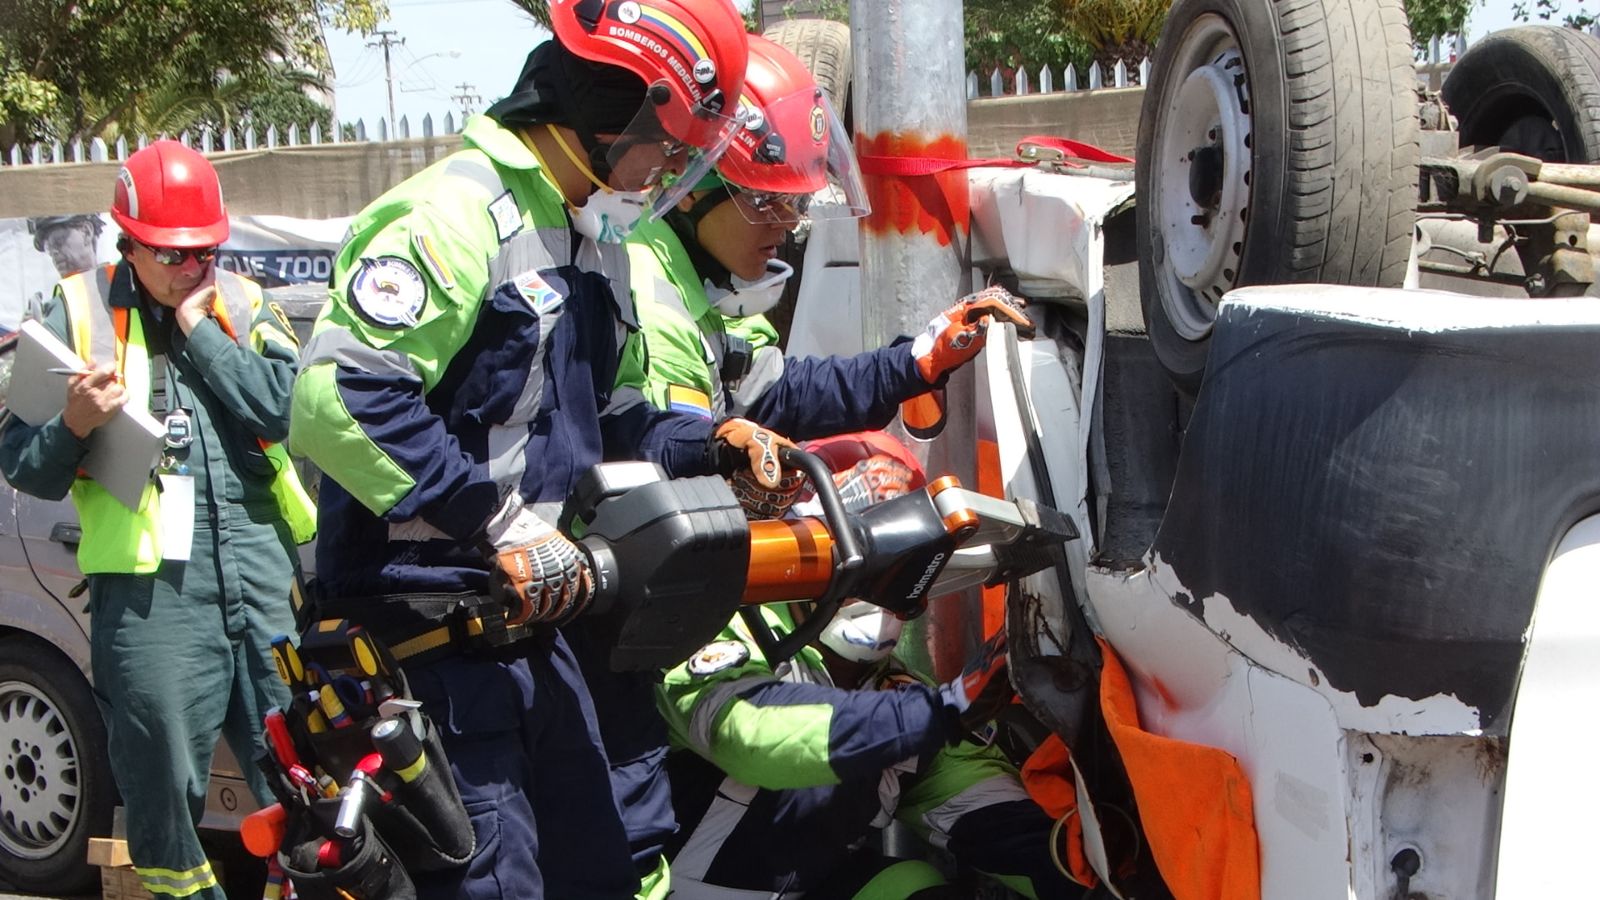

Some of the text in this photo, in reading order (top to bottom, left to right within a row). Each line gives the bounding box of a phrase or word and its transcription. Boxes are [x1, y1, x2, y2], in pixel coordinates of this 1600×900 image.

[609, 26, 702, 102] BOMBEROS MEDELLIN
[275, 255, 334, 279] TOO
[905, 552, 945, 599] holmatro
